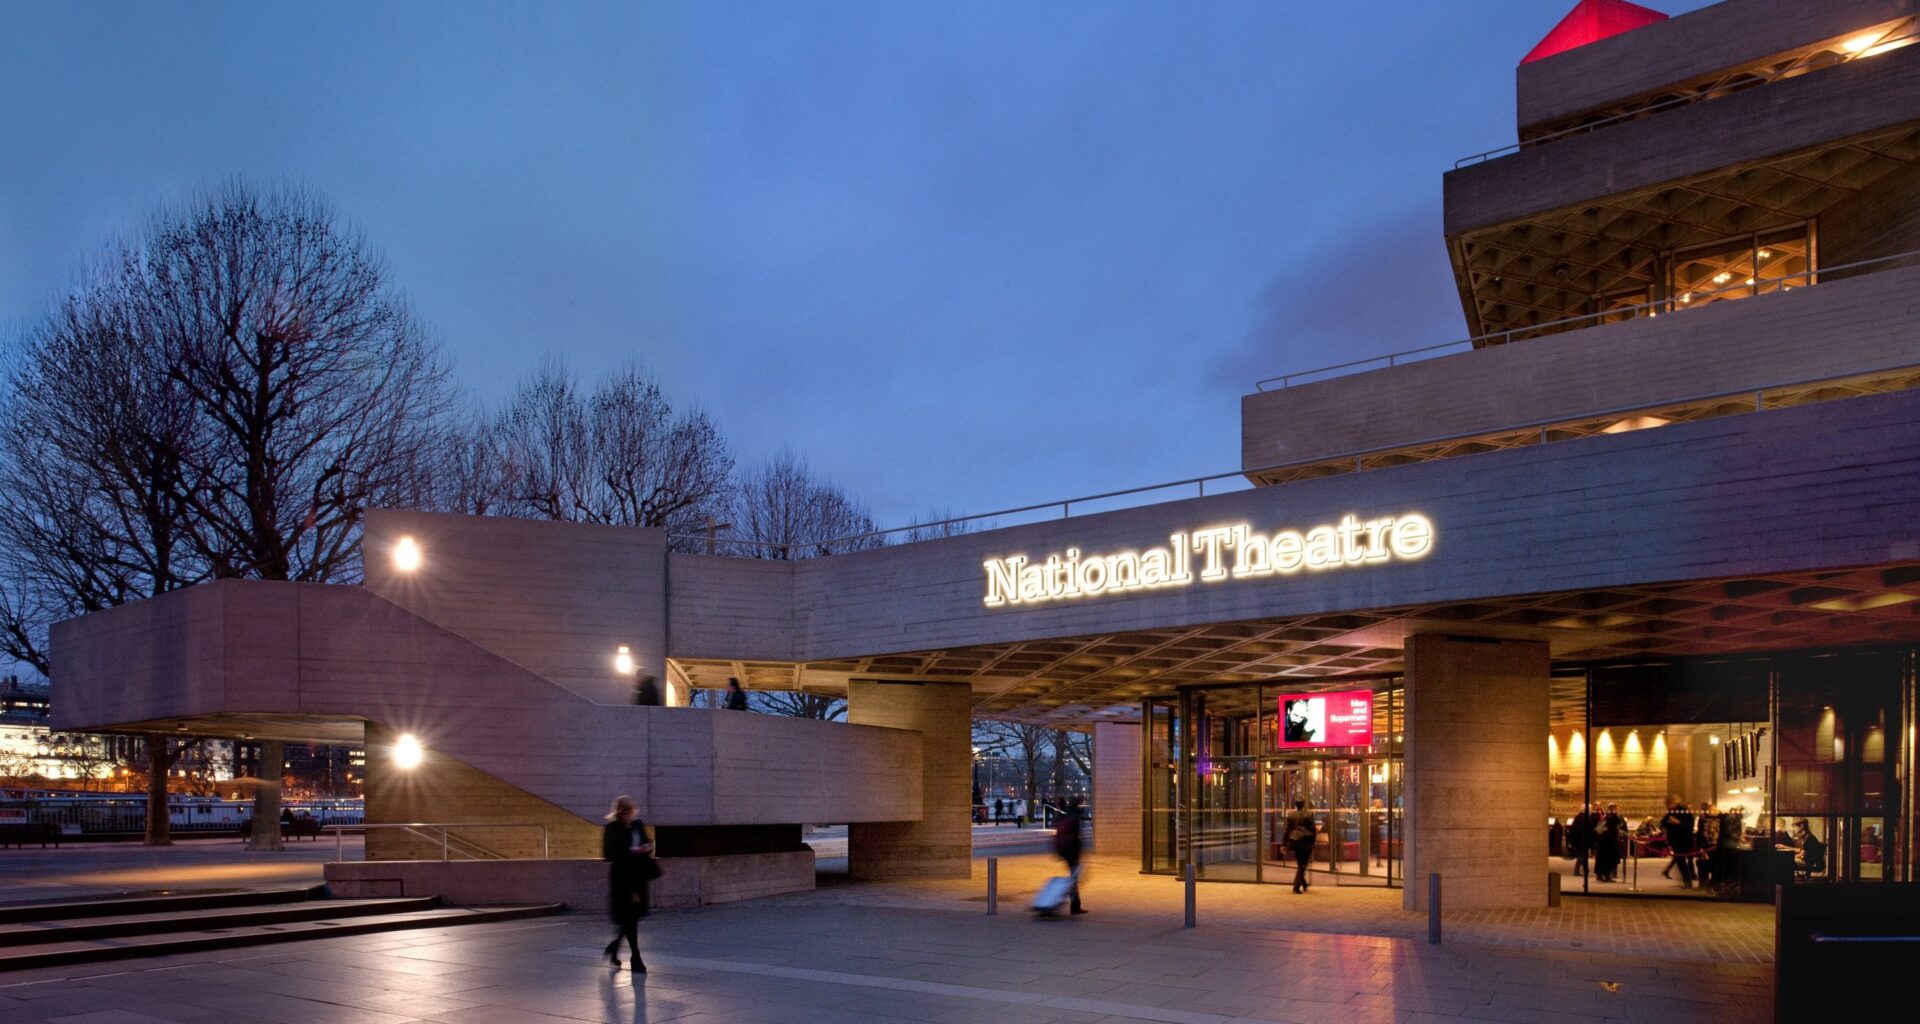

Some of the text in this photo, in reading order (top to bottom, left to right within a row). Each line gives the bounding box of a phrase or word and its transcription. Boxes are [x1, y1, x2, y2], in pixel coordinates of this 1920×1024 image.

[983, 513, 1433, 607] National Theatre
[1353, 706, 1367, 714] and
[1330, 714, 1367, 723] Superman
